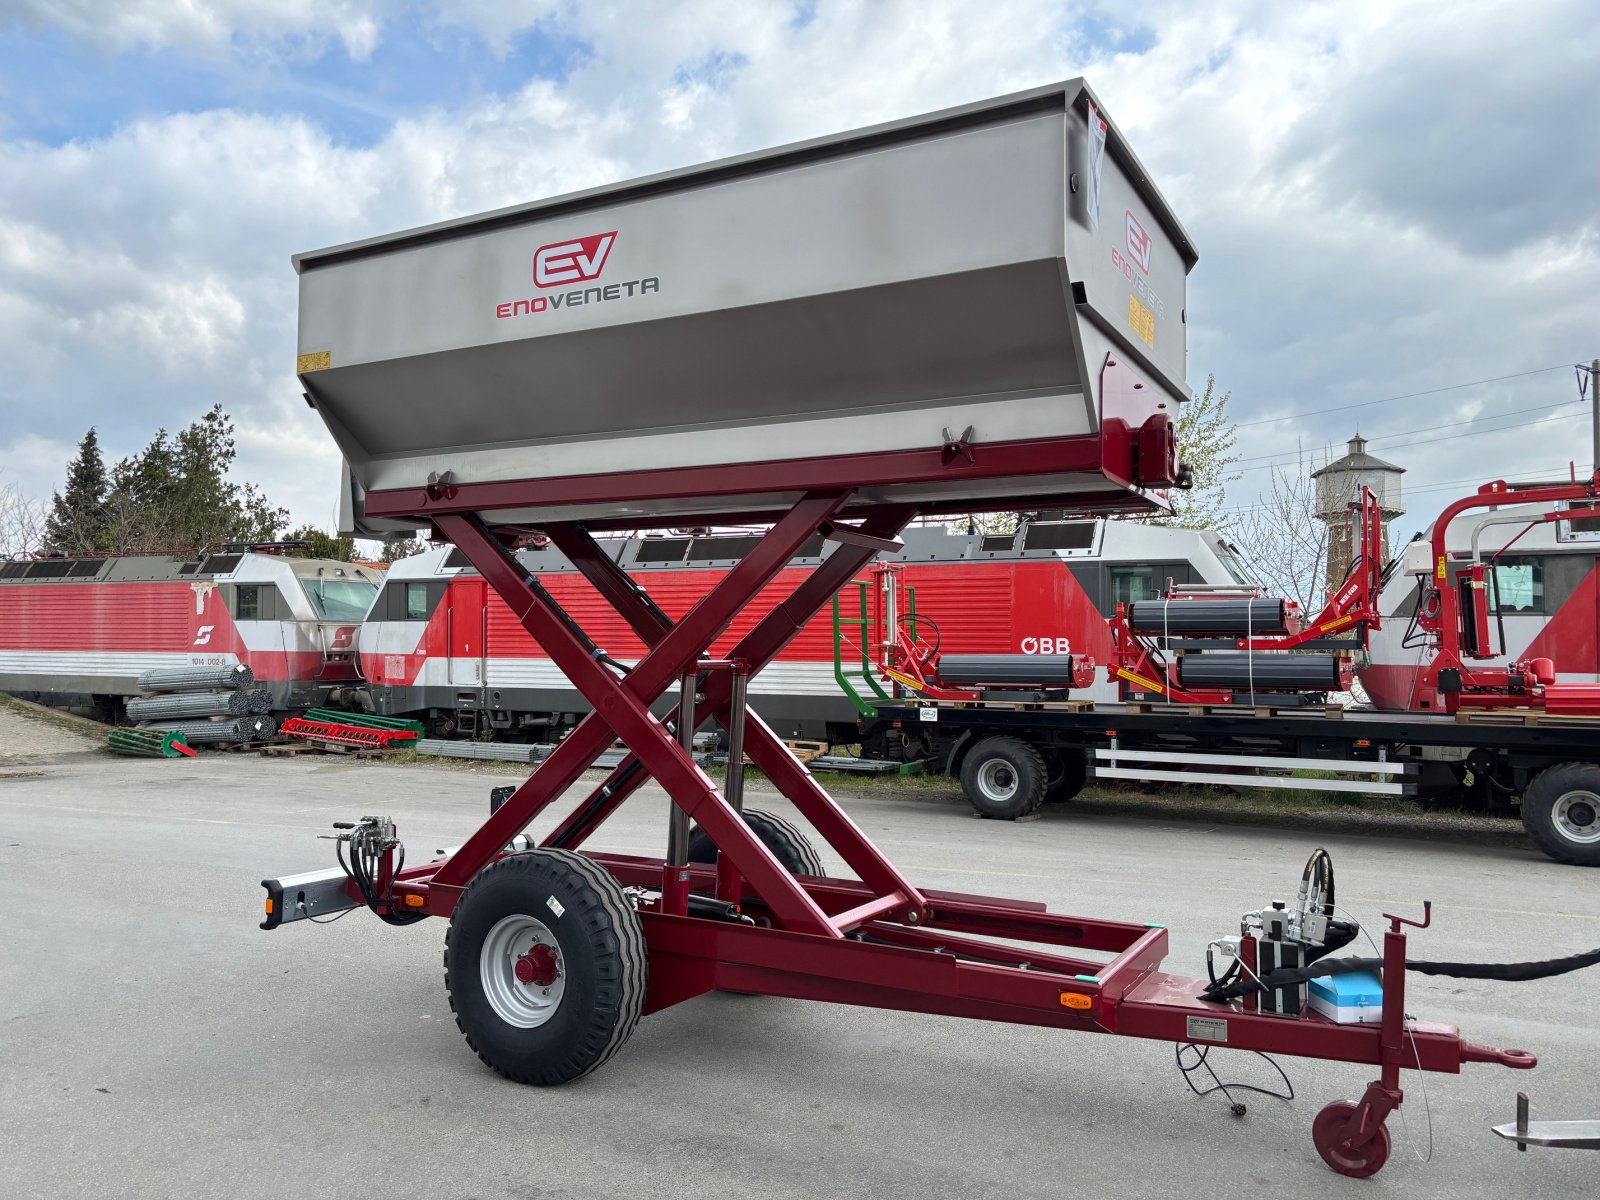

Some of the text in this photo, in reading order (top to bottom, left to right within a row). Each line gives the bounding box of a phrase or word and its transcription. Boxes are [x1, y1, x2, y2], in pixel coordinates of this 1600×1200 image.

[1126, 210, 1152, 275] EV
[534, 231, 618, 288] EV
[496, 276, 660, 319] ENOVENETA
[464, 644, 469, 653] 1
[1021, 636, 1070, 655] ÖBB
[192, 658, 226, 666] 1014 002-8
